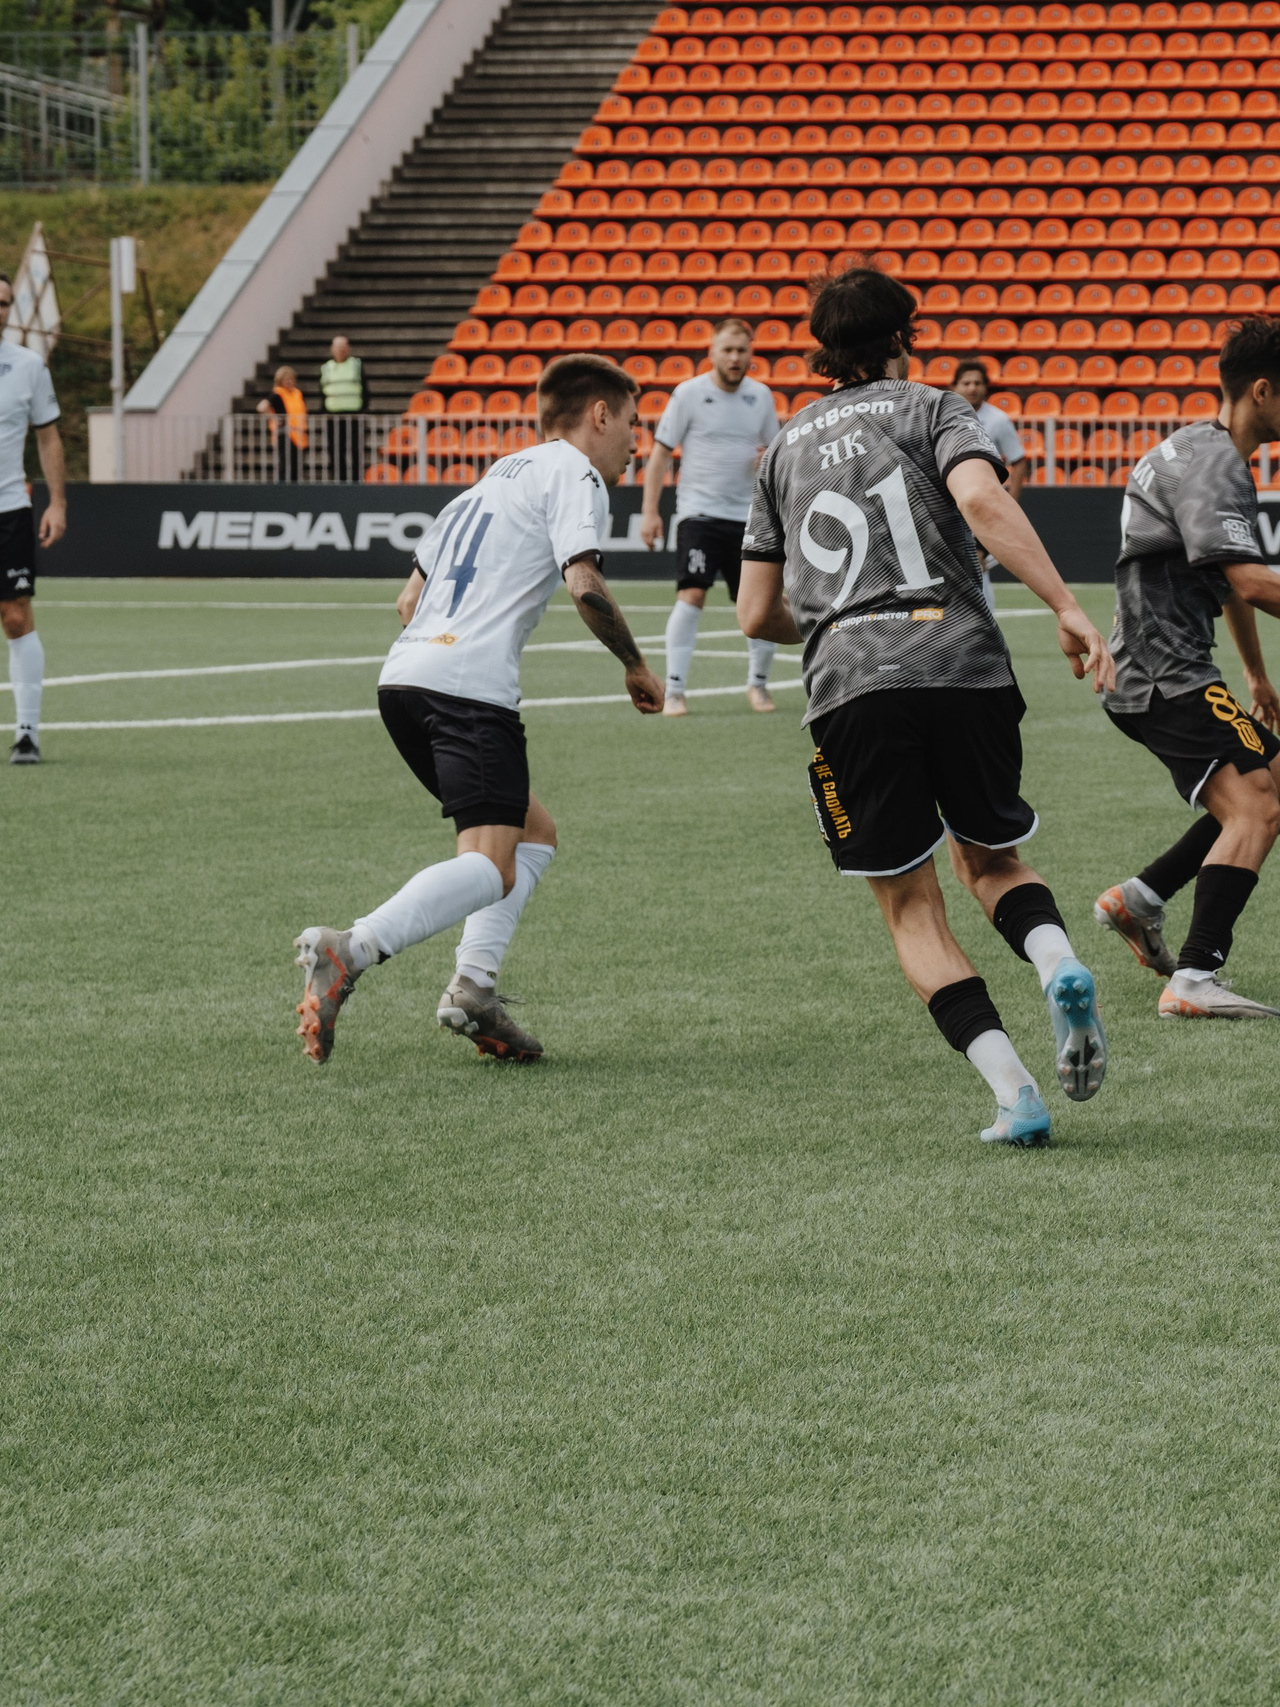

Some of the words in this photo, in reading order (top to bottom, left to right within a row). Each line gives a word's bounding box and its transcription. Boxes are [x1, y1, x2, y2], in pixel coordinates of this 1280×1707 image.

[786, 400, 895, 445] BetBoom
[818, 429, 868, 470] ЯК
[158, 511, 352, 550] MEDIA
[800, 464, 944, 610] 91
[914, 610, 941, 620] PRO
[814, 764, 833, 779] НЕ
[822, 781, 852, 839] СЛОМАТЬ
